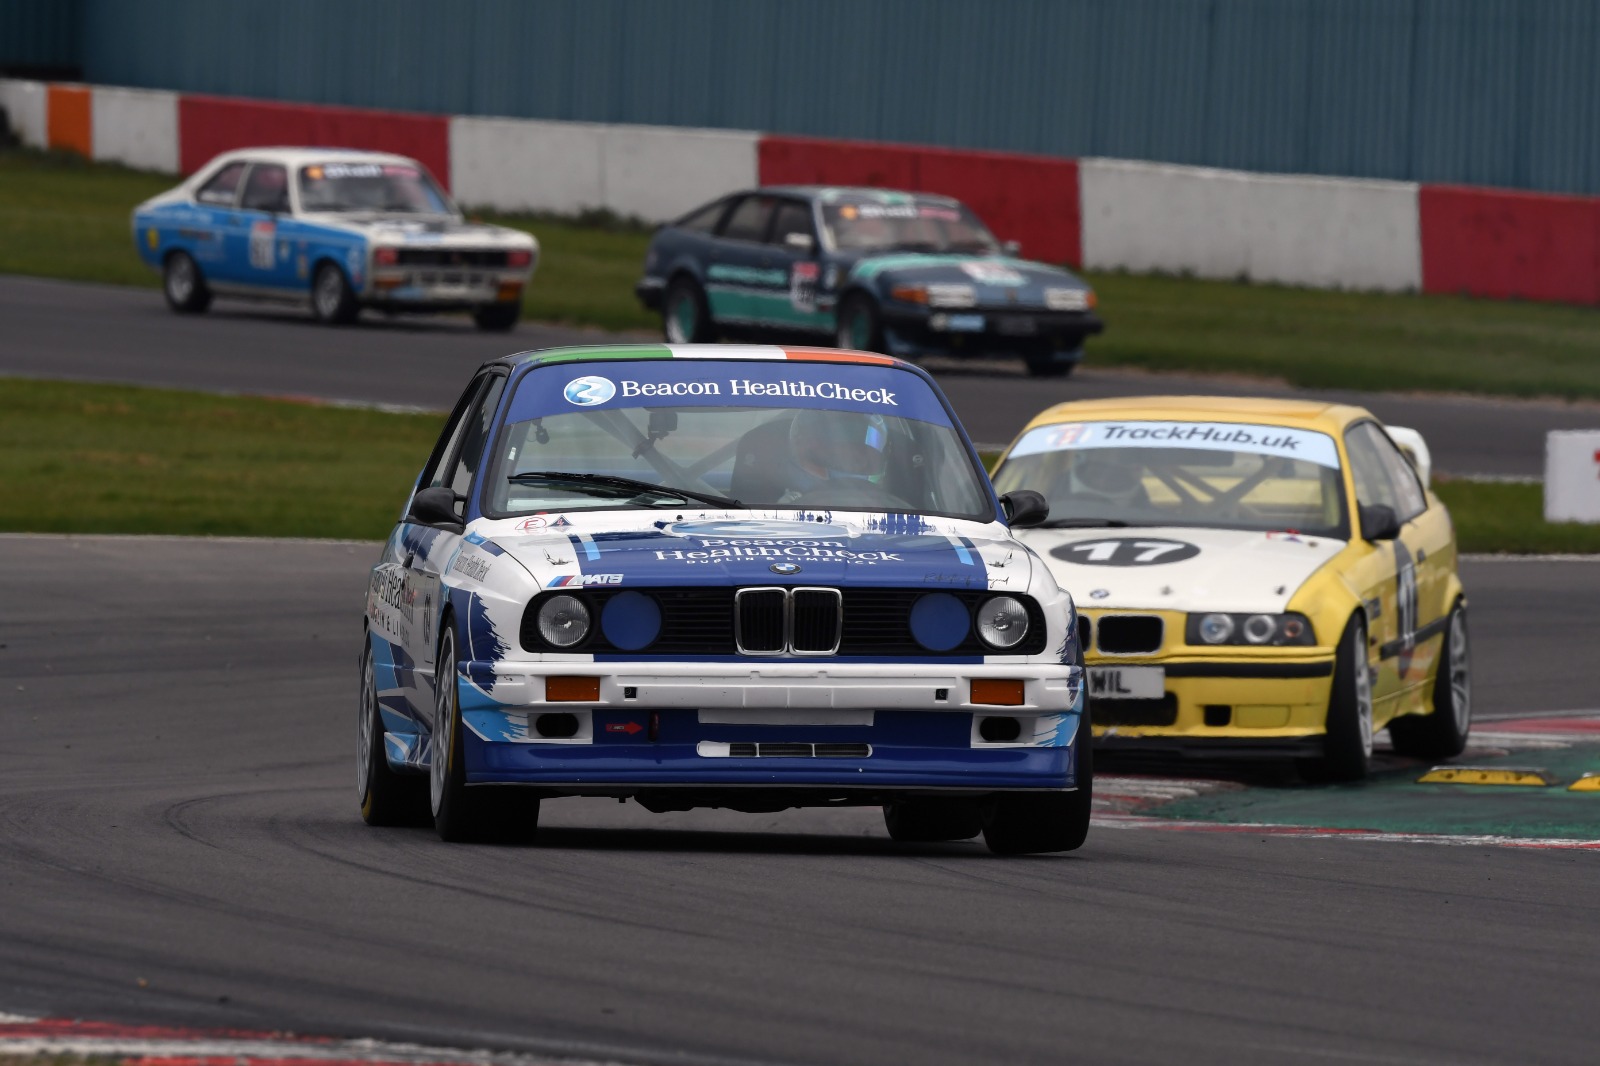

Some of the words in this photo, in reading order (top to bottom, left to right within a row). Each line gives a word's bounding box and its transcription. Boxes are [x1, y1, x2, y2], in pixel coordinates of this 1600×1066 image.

[620, 380, 720, 397] Beacon
[729, 379, 898, 406] HealthCheck
[1103, 425, 1301, 451] TrackHub.uk
[702, 539, 846, 548] Beacon
[1073, 541, 1185, 562] 17
[656, 546, 904, 562] HealthCheck
[686, 557, 752, 565] DUBLIN
[787, 556, 877, 565] LIMERICK
